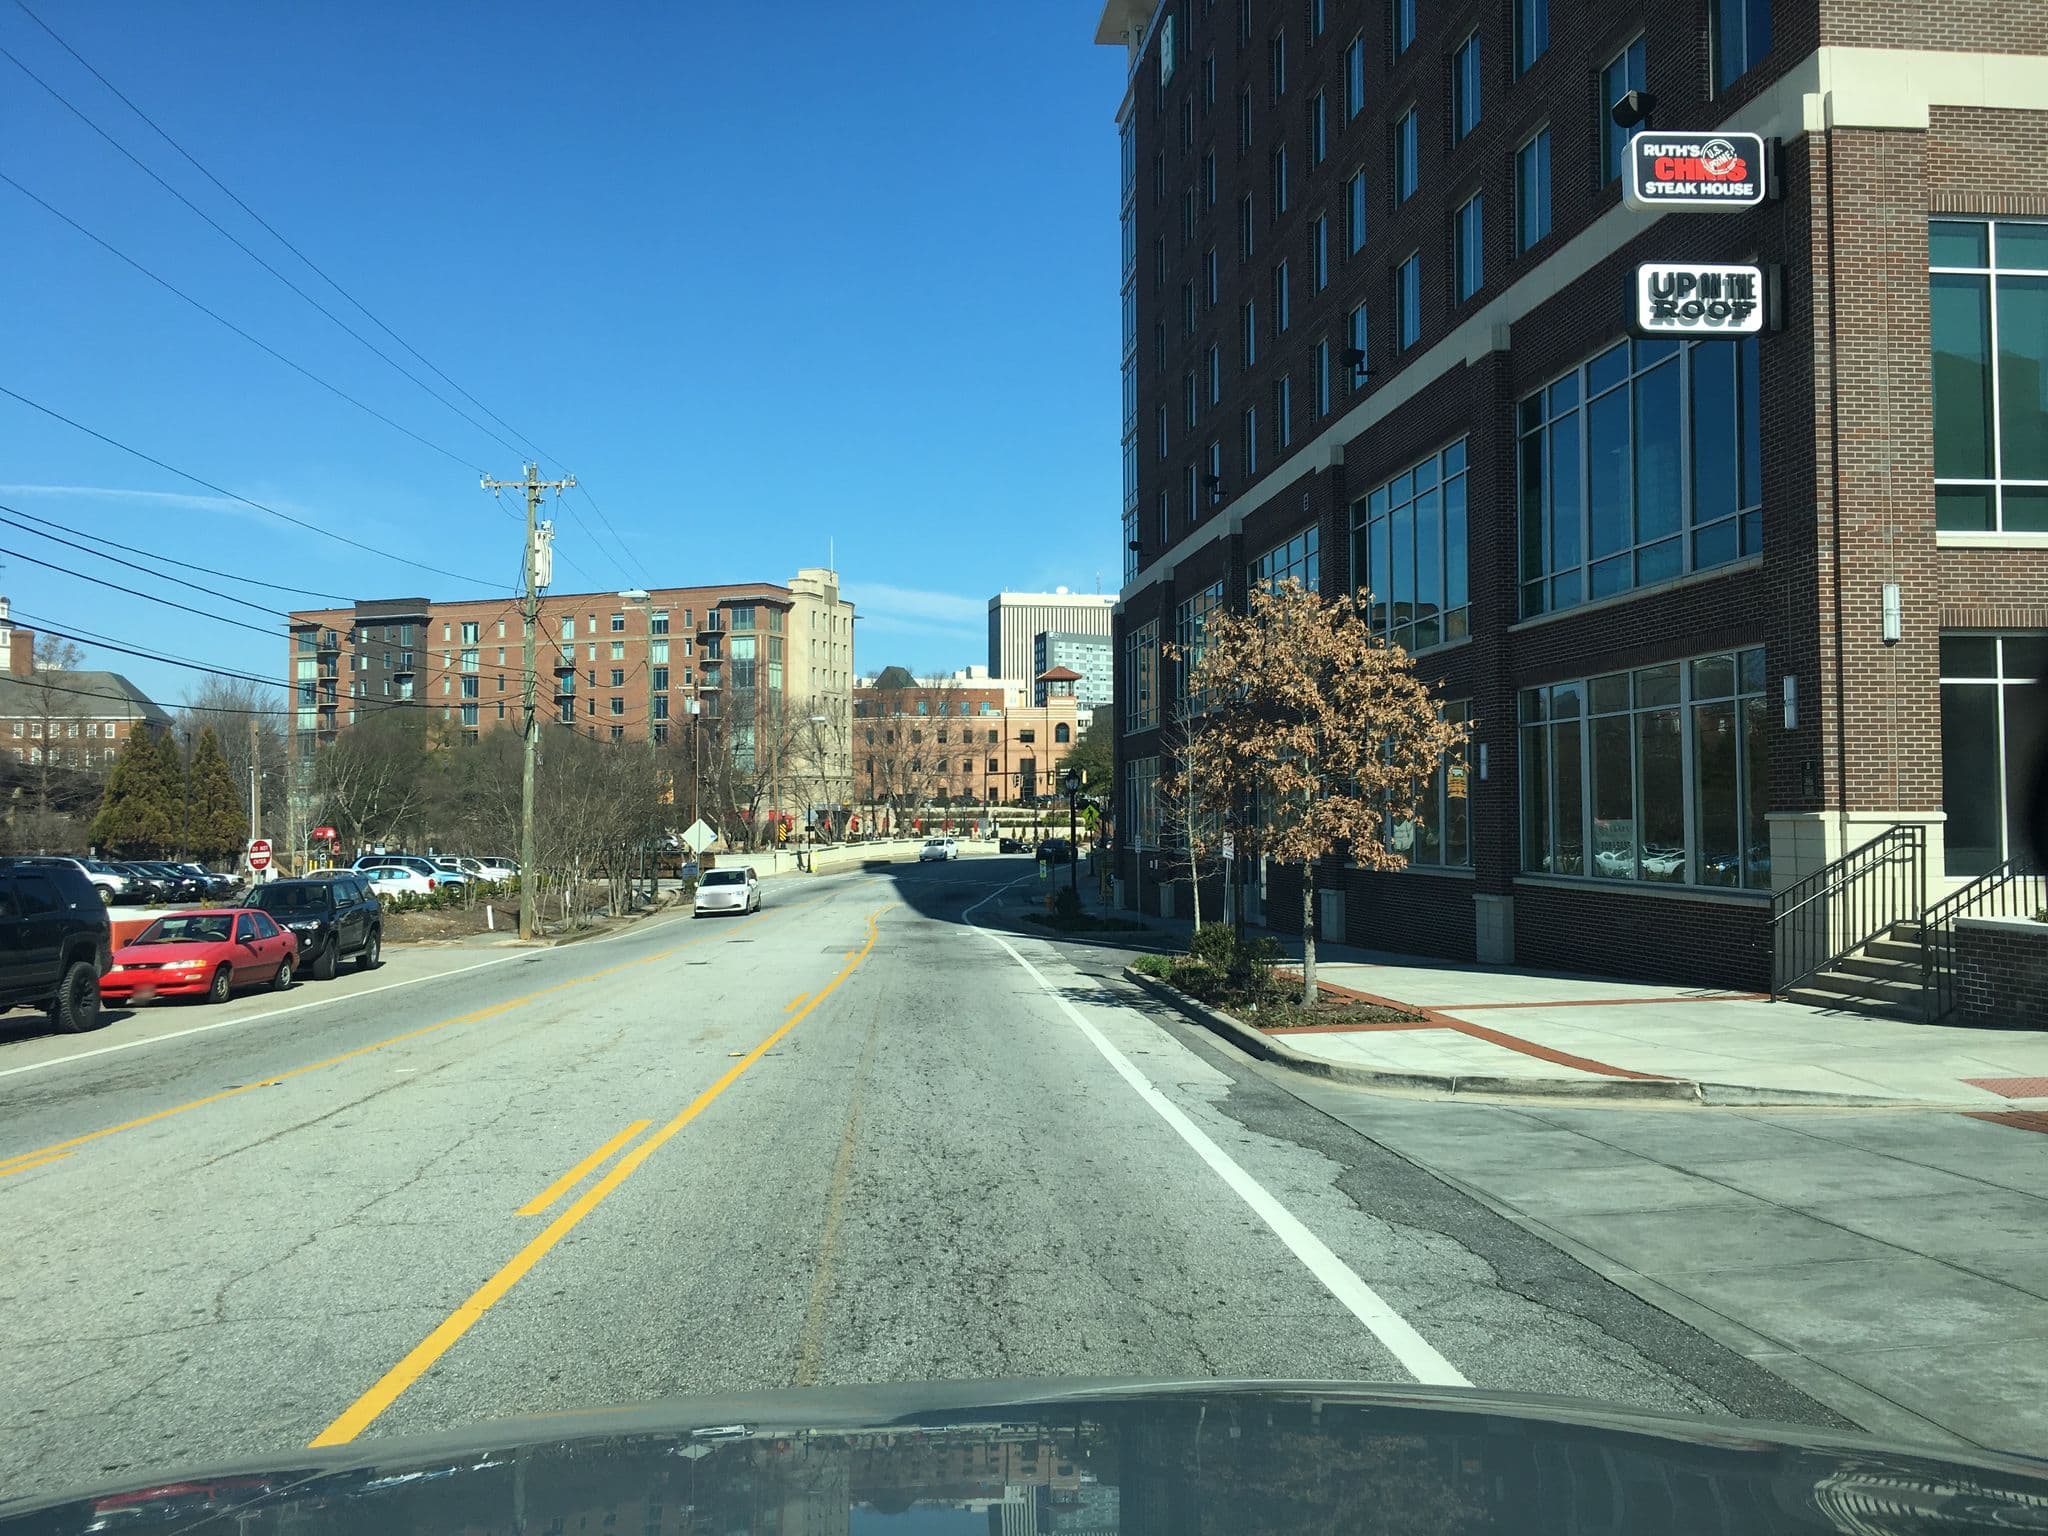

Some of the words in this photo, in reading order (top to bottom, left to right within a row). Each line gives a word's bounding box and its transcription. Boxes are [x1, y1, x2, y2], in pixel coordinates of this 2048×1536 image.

[1643, 144, 1701, 157] RUTH'S
[1706, 145, 1724, 159] U.S.
[1645, 181, 1698, 195] STEAK
[1701, 182, 1754, 196] HOUSE
[1650, 272, 1697, 299] UP
[1699, 272, 1722, 299] ON
[1725, 273, 1757, 300] THE
[1651, 299, 1757, 322] ROOF
